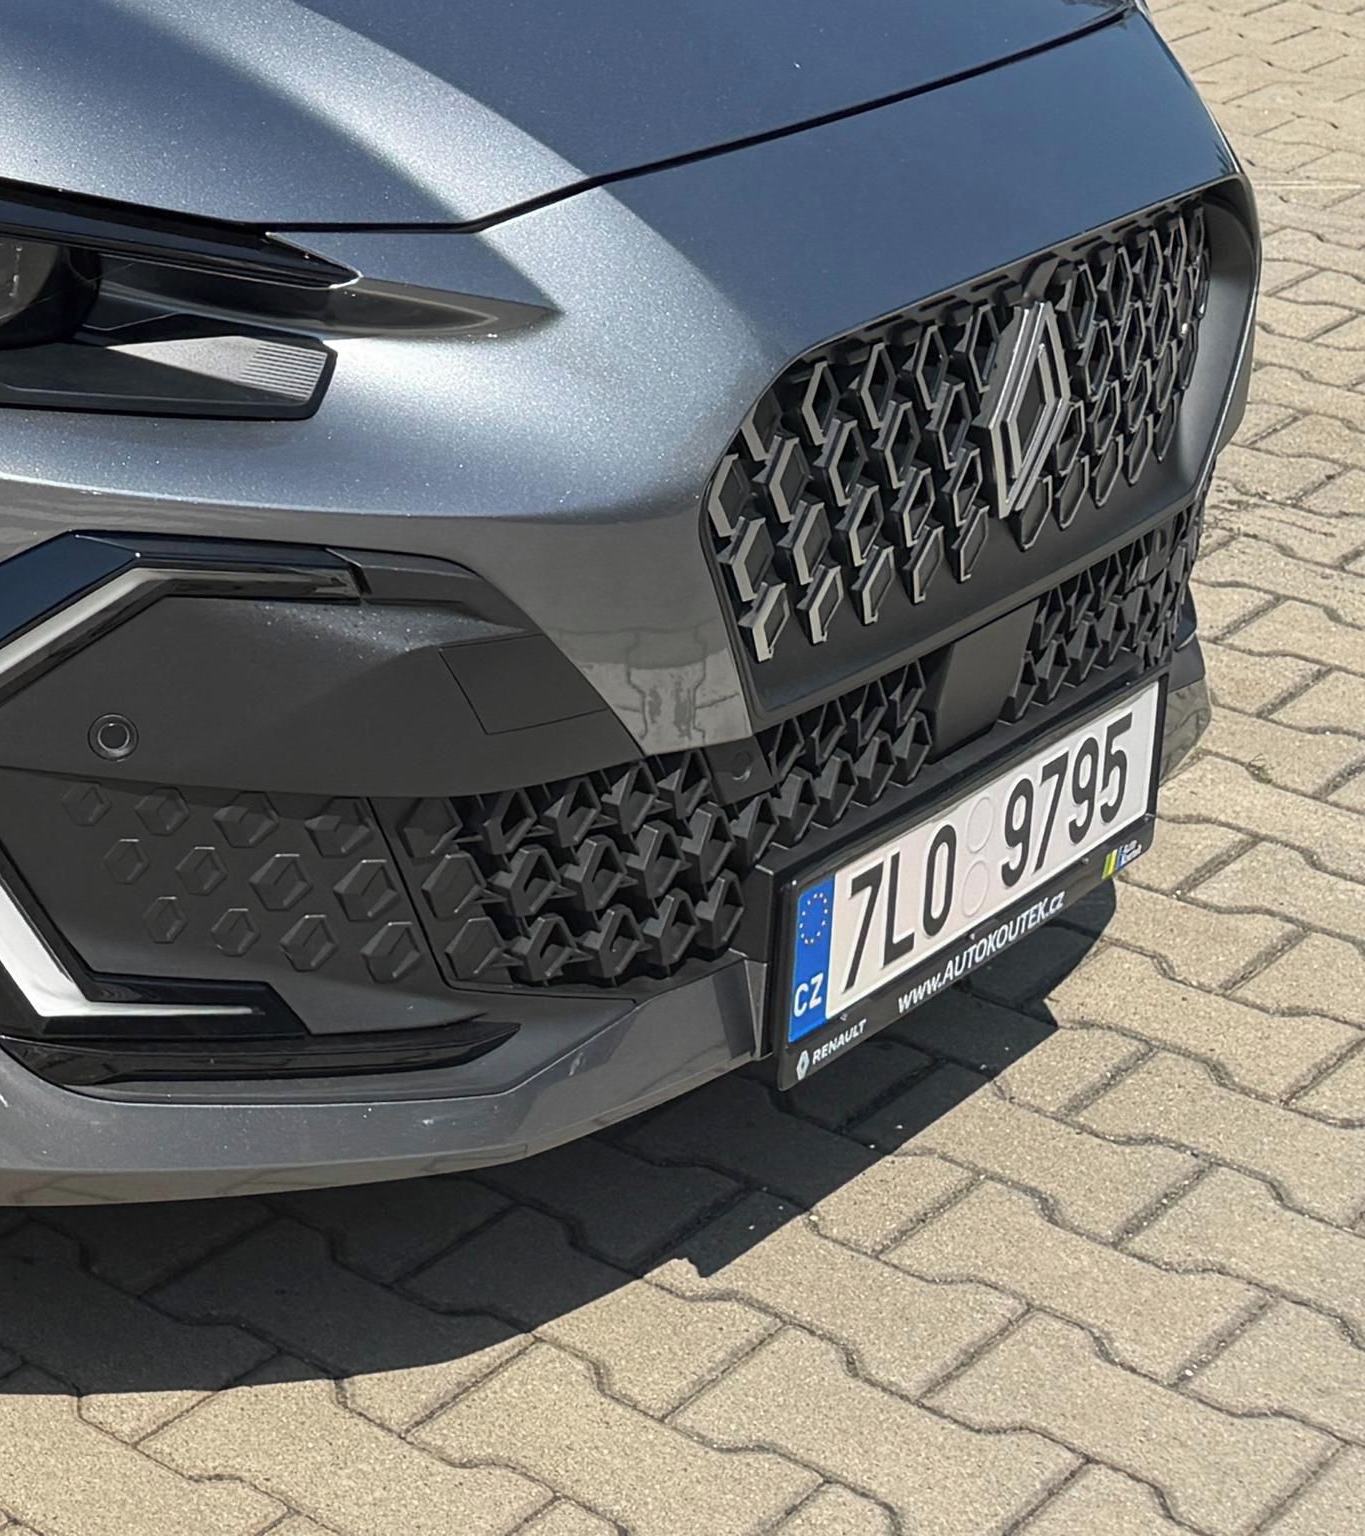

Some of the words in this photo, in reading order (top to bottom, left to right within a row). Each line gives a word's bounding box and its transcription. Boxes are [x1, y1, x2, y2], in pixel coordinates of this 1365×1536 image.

[1001, 711, 1133, 889] 9795
[794, 972, 824, 1018] CZ
[812, 1018, 867, 1065] RENAULT
